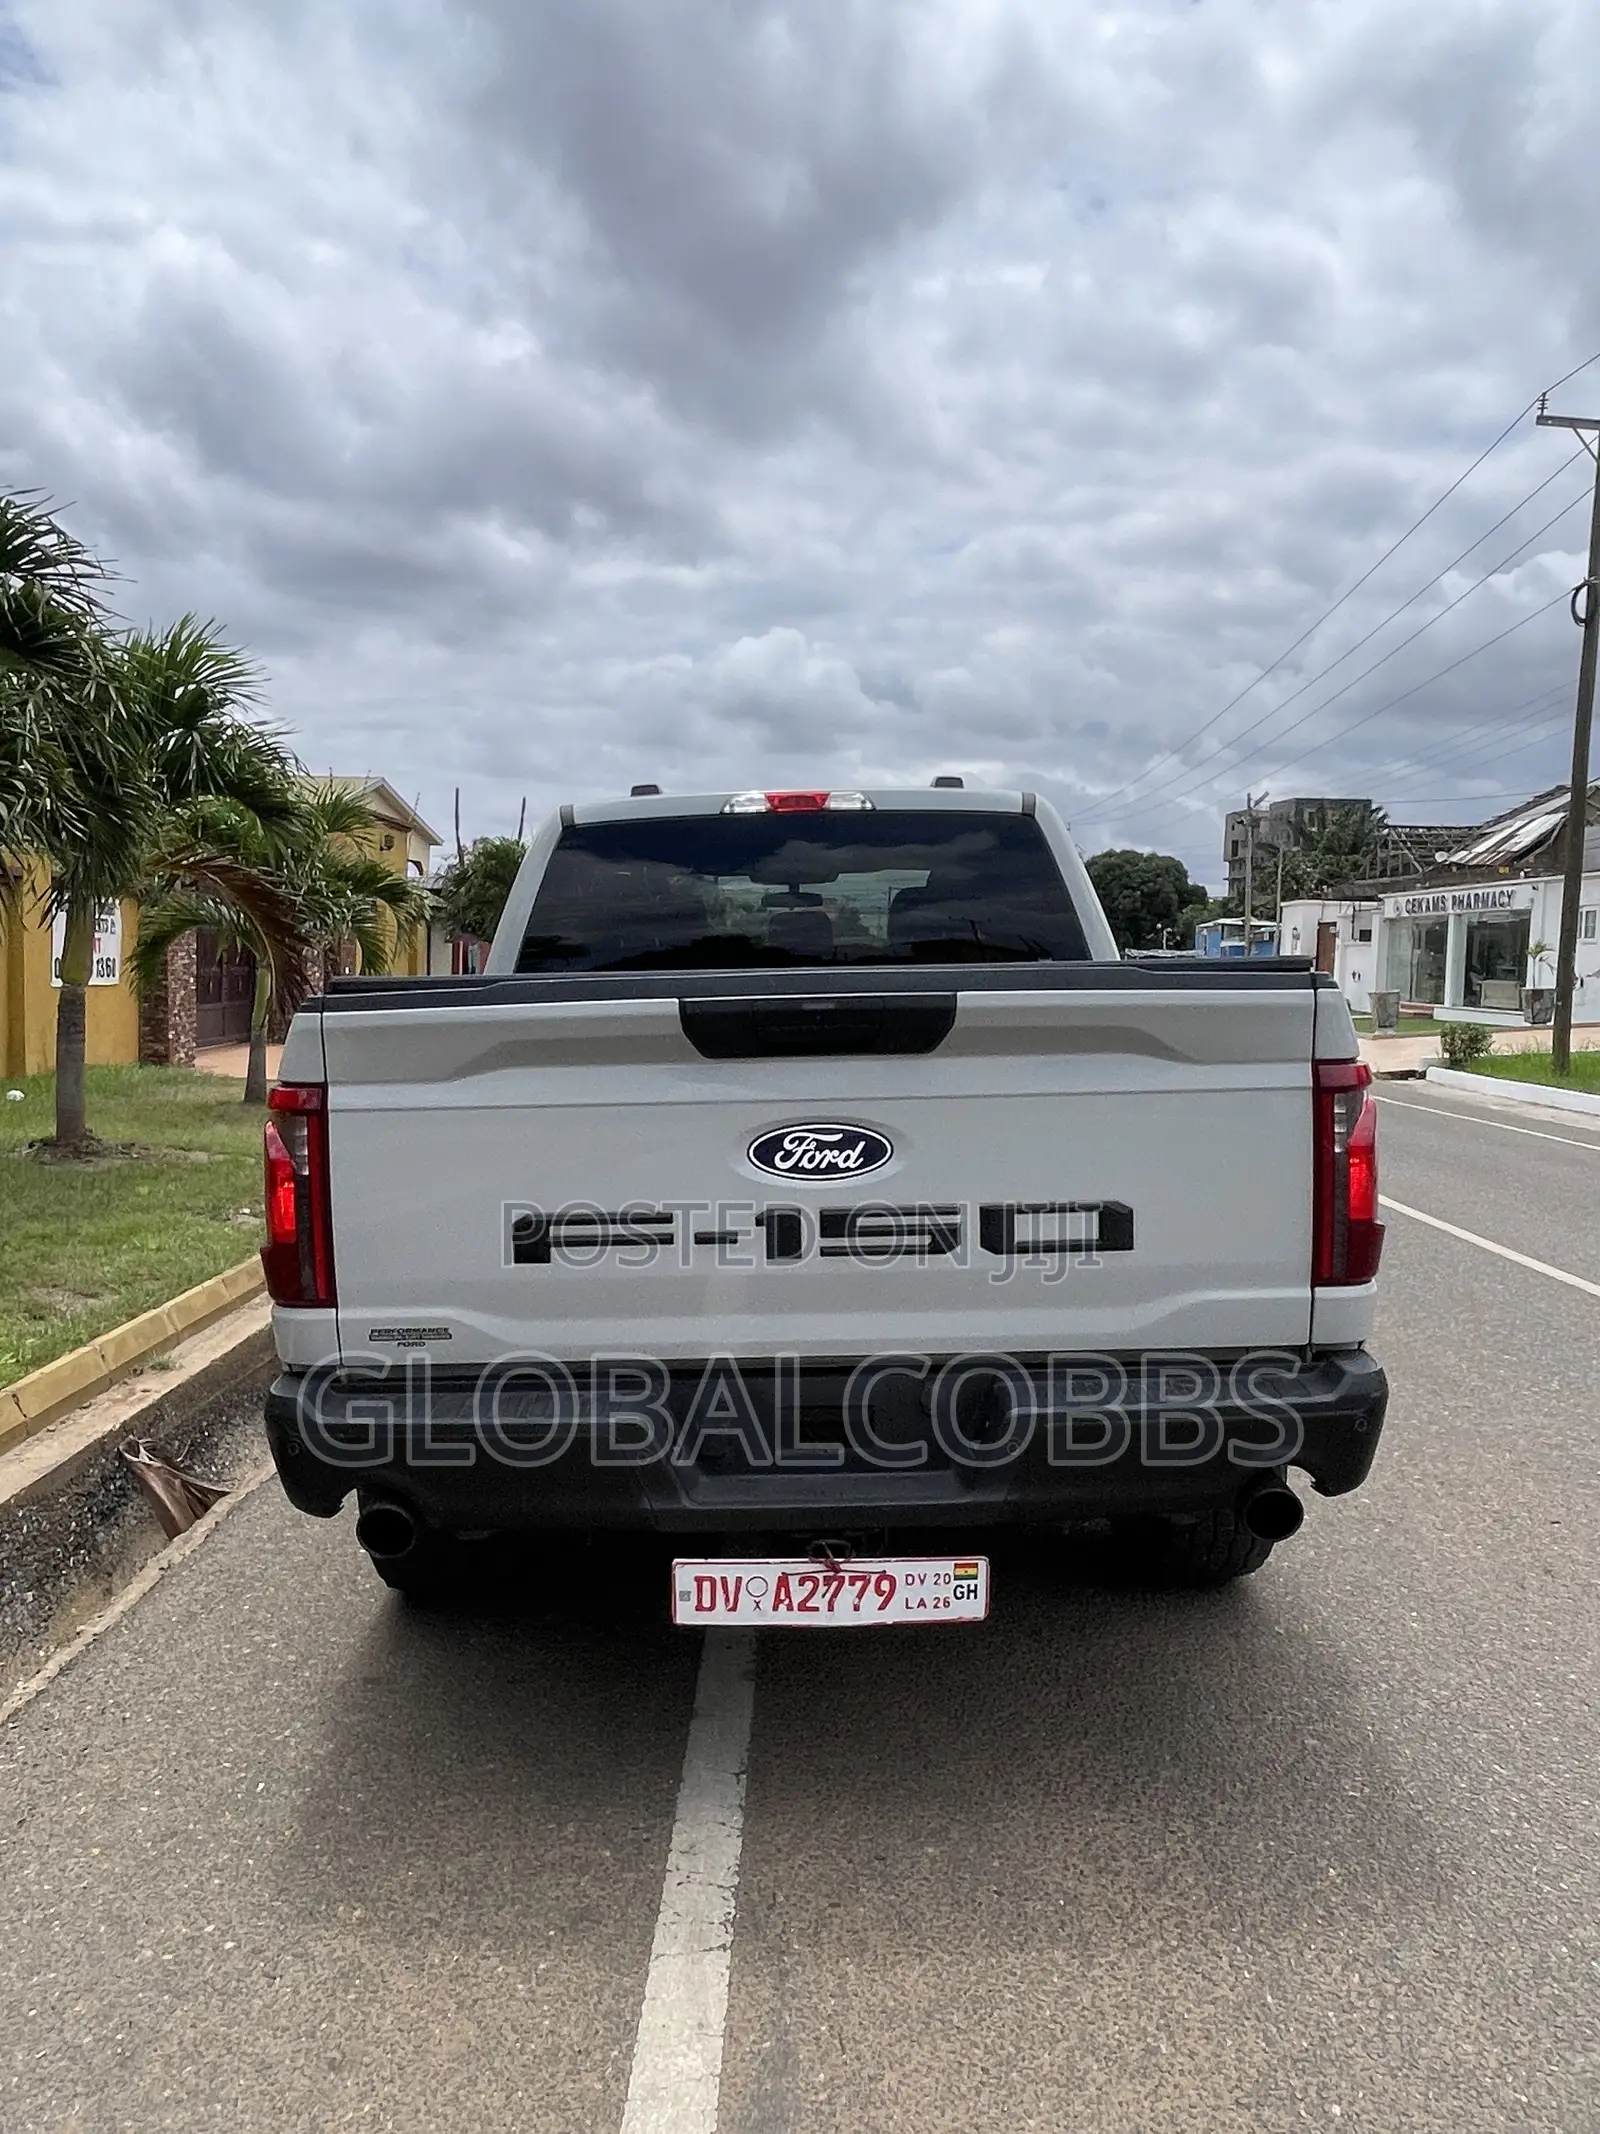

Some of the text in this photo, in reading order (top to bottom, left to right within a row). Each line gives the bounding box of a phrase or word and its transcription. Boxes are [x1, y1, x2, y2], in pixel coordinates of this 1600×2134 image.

[1404, 889, 1516, 915] CEKAMS PHARMACY
[773, 1131, 867, 1170] Ford
[512, 1200, 1134, 1264] F-150
[694, 1575, 743, 1612] DV
[771, 1573, 897, 1612] A2779
[905, 1573, 952, 1586] DV 20
[953, 1584, 979, 1600] GH
[905, 1597, 951, 1610] LA 26
